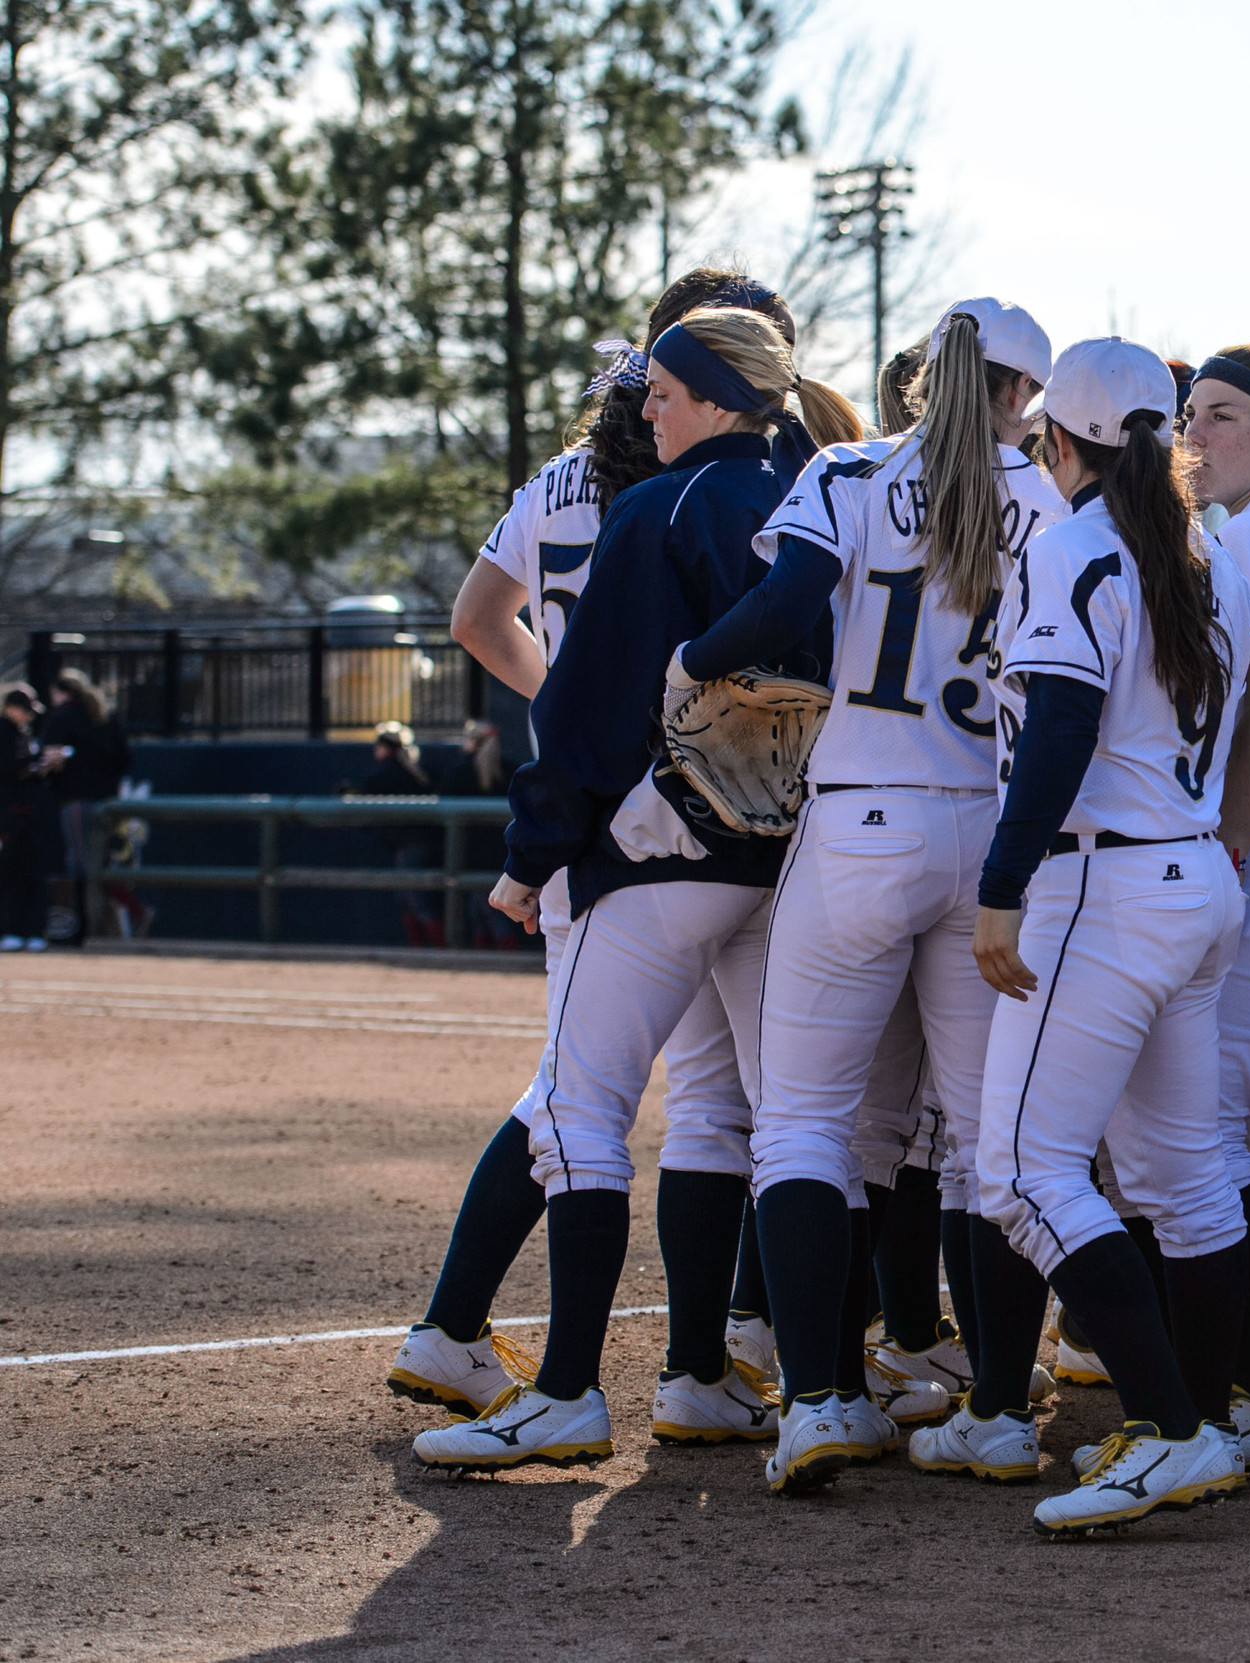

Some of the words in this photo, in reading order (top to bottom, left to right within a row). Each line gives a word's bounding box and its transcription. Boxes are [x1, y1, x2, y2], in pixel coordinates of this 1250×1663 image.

[546, 455, 600, 517] PIER
[847, 566, 998, 738] 15
[1028, 626, 1059, 640] ACC
